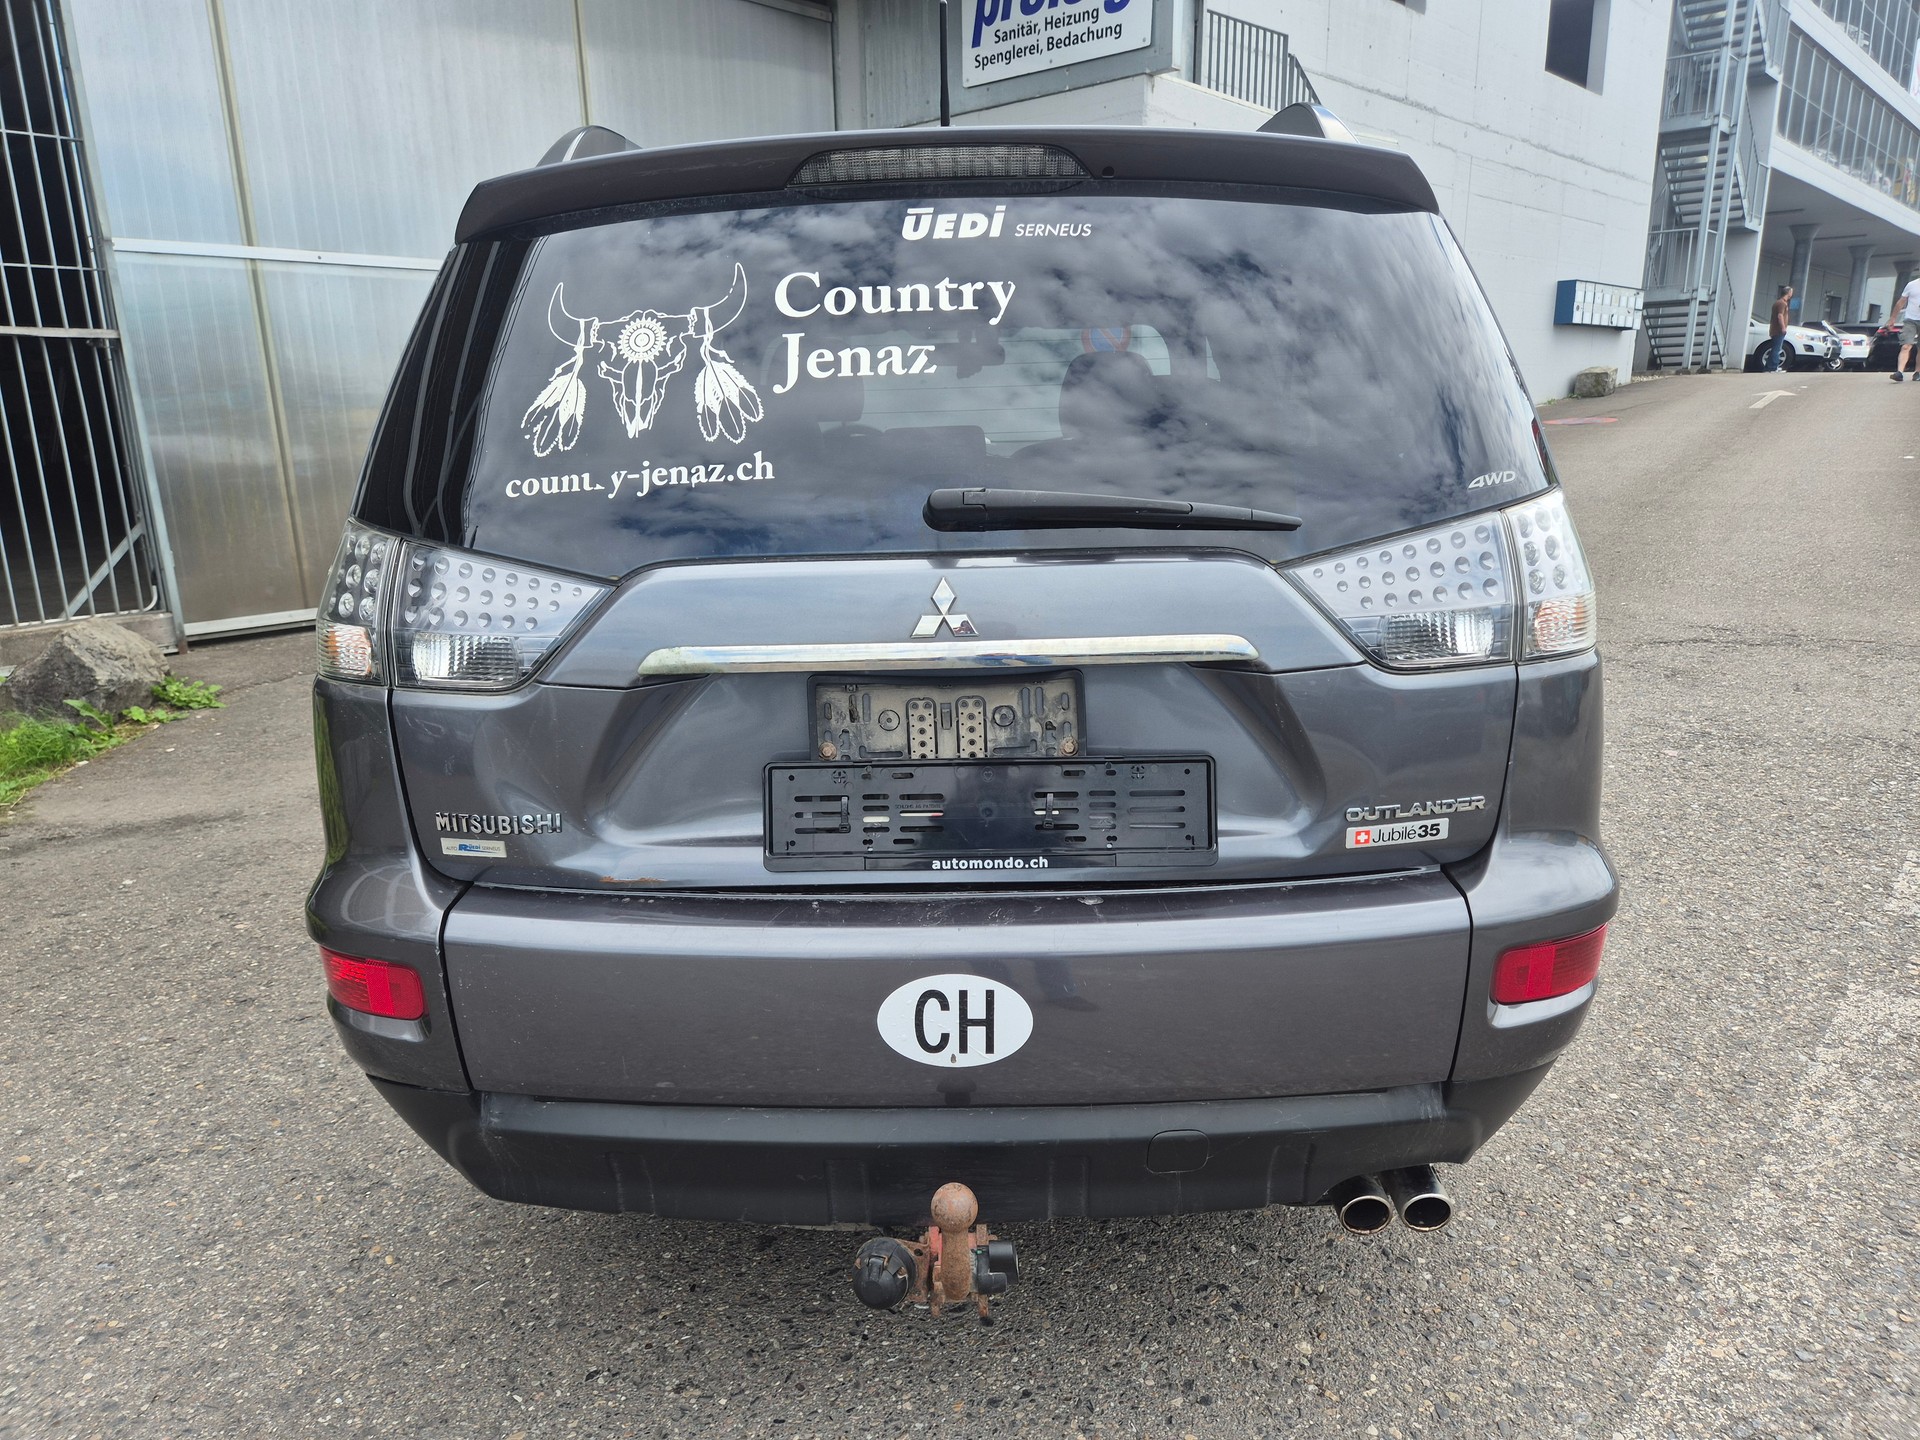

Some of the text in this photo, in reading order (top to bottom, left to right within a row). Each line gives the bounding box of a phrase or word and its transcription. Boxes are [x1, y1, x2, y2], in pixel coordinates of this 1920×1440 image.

[994, 20, 1041, 44] Sanitär,
[1044, 7, 1099, 32] Heizung
[974, 39, 1043, 71] Spenglerei,
[1046, 23, 1123, 52] Bedachung
[1014, 223, 1092, 237] SERNEUS
[774, 271, 1016, 326] Country
[772, 332, 938, 394] Jenaz
[1468, 470, 1516, 489] 4WD
[435, 811, 563, 835] MITSUBISHI
[1345, 795, 1486, 823] OUTLANDER
[931, 856, 1049, 871] automondo.ch
[914, 989, 995, 1054] CH
